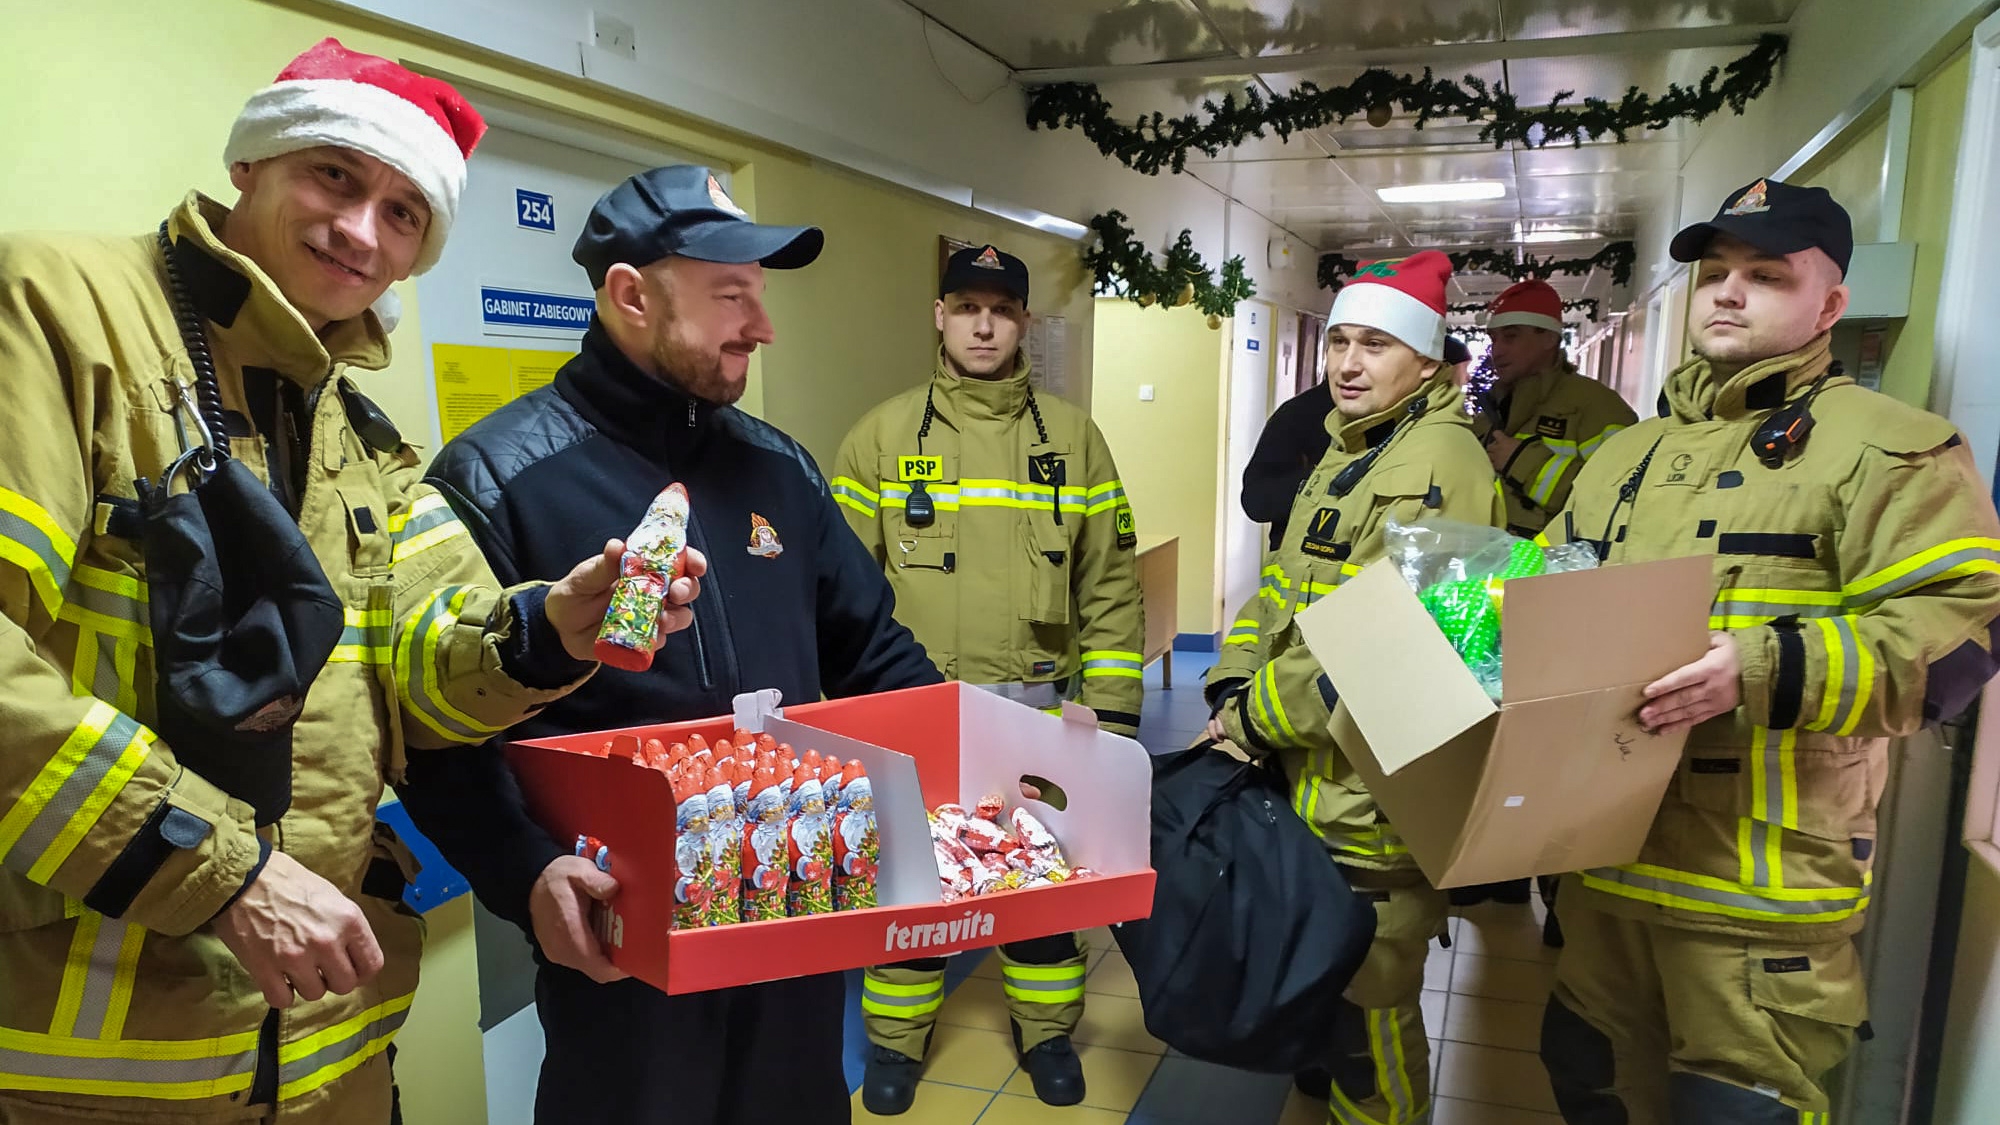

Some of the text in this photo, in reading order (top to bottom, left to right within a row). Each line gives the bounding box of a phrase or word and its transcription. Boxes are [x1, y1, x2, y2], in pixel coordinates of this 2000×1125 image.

[521, 199, 551, 225] 254
[484, 298, 592, 322] GABINET ZABIEGOWY
[905, 459, 936, 477] PSP
[885, 909, 995, 952] terravita
